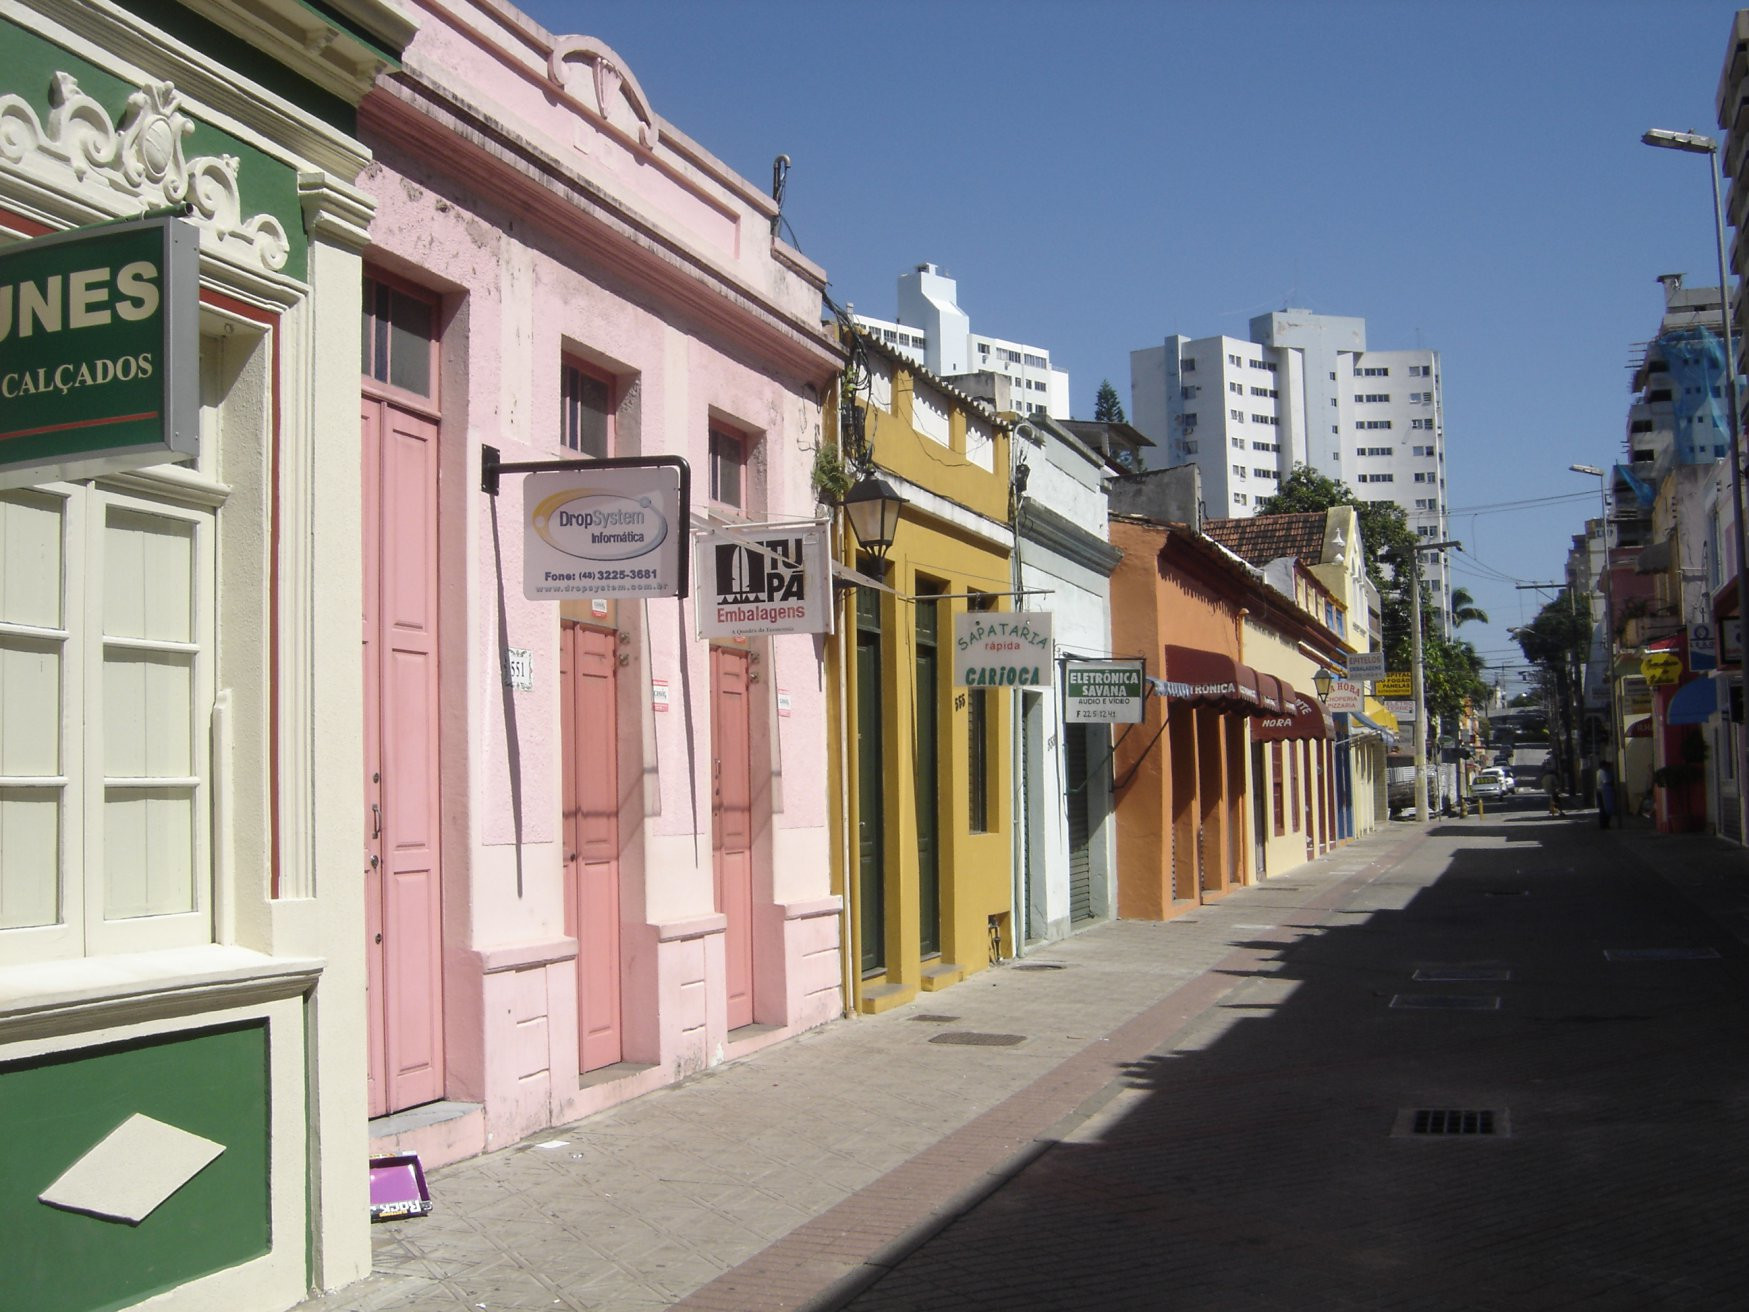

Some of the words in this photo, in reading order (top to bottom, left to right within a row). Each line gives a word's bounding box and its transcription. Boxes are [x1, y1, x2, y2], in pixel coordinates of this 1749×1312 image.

[1, 352, 153, 398] CALÇADOS
[559, 509, 645, 529] DropSystem
[591, 531, 645, 544] Informática
[544, 571, 576, 581] Fone:
[578, 571, 596, 581] (48)
[597, 569, 658, 581] 3225-3681
[717, 605, 805, 624] Embalagens
[957, 622, 1049, 651] SAPATARIA
[1070, 670, 1139, 684] ELETRÔNICA
[1082, 685, 1127, 697] SAVANA
[1337, 682, 1360, 697] HORA
[1262, 718, 1292, 728] HORA
